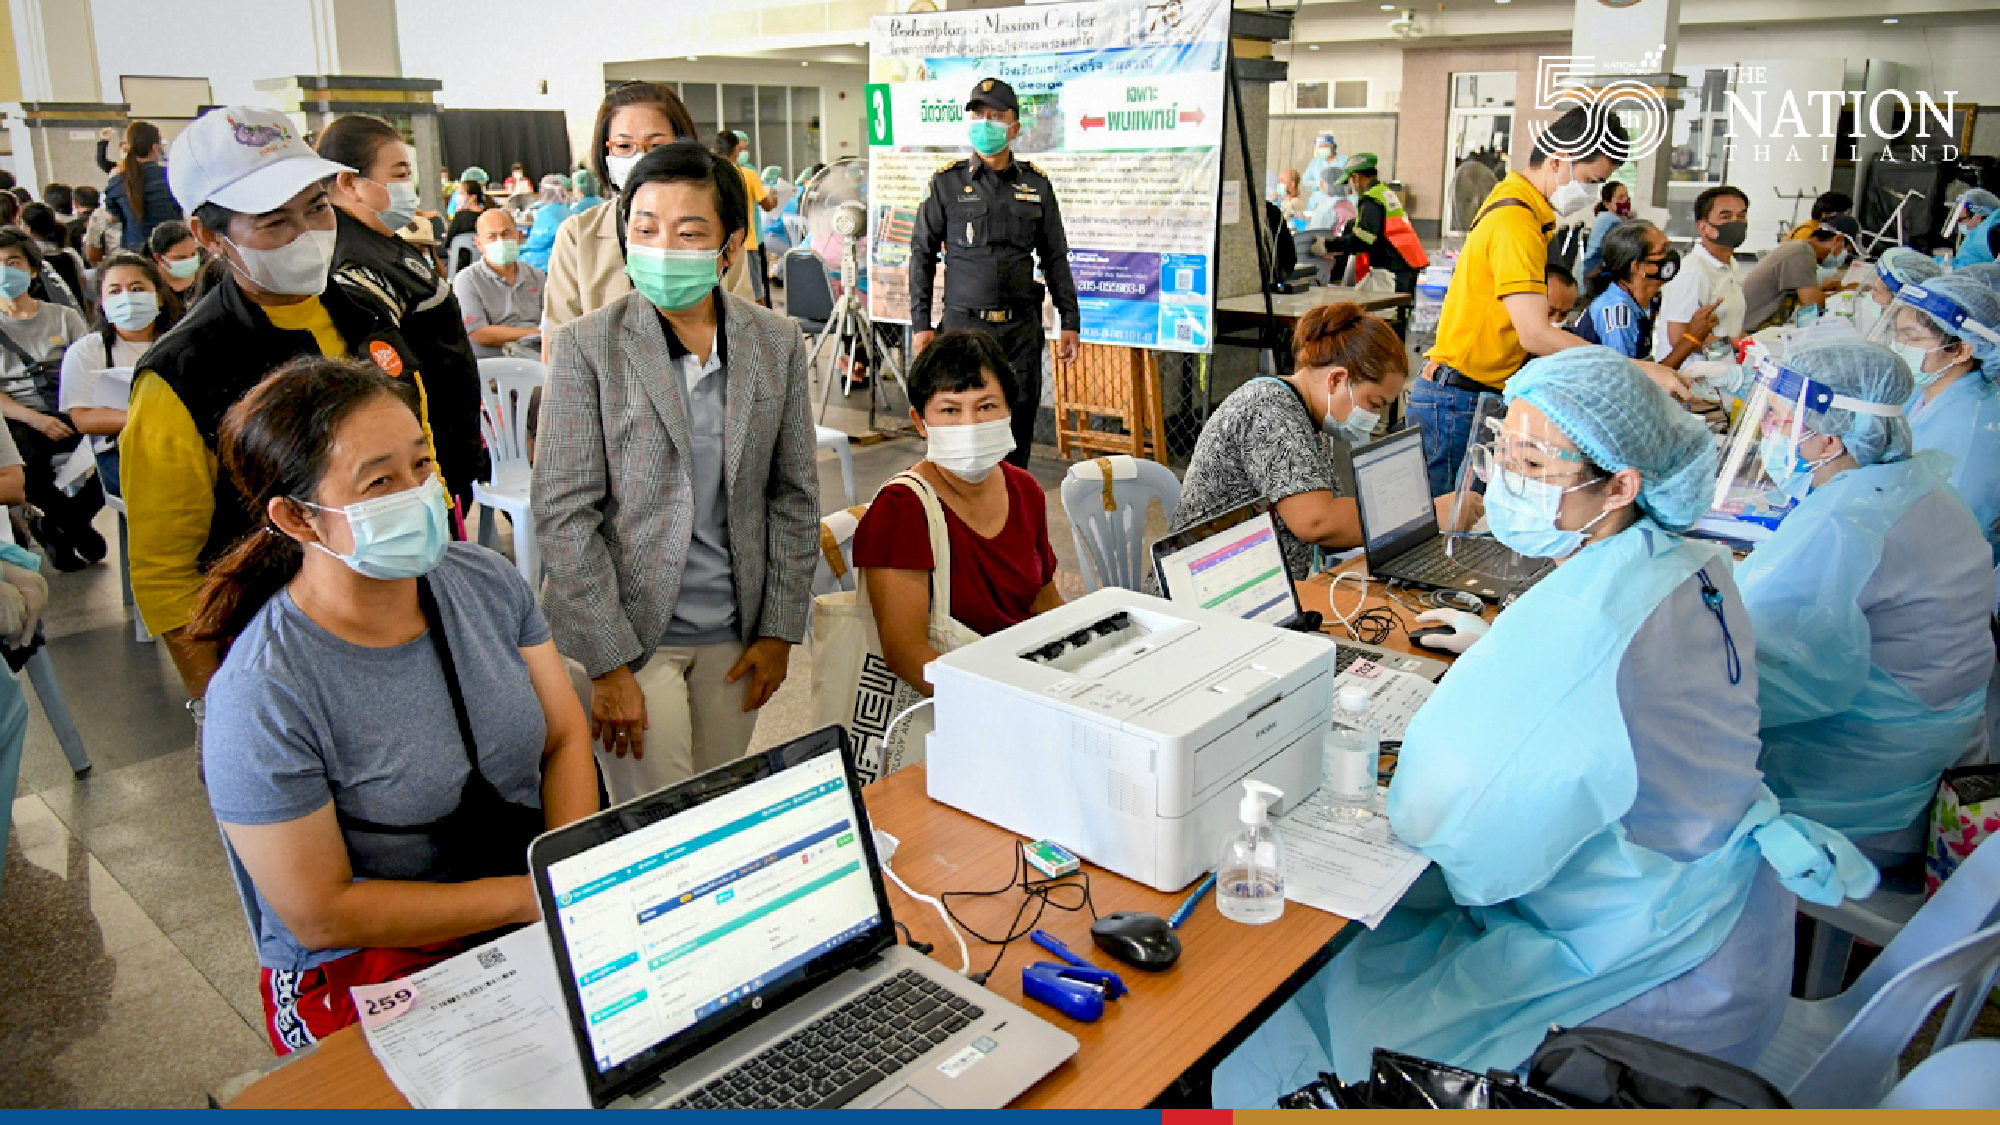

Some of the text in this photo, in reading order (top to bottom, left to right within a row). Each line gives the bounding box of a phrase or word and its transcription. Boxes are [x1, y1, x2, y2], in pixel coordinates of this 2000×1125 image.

[984, 13, 1041, 34] Mission
[872, 89, 886, 140] 3
[1107, 101, 1178, 131] พบแพทย์
[1602, 302, 1631, 333] 10
[364, 988, 412, 1017] 259
